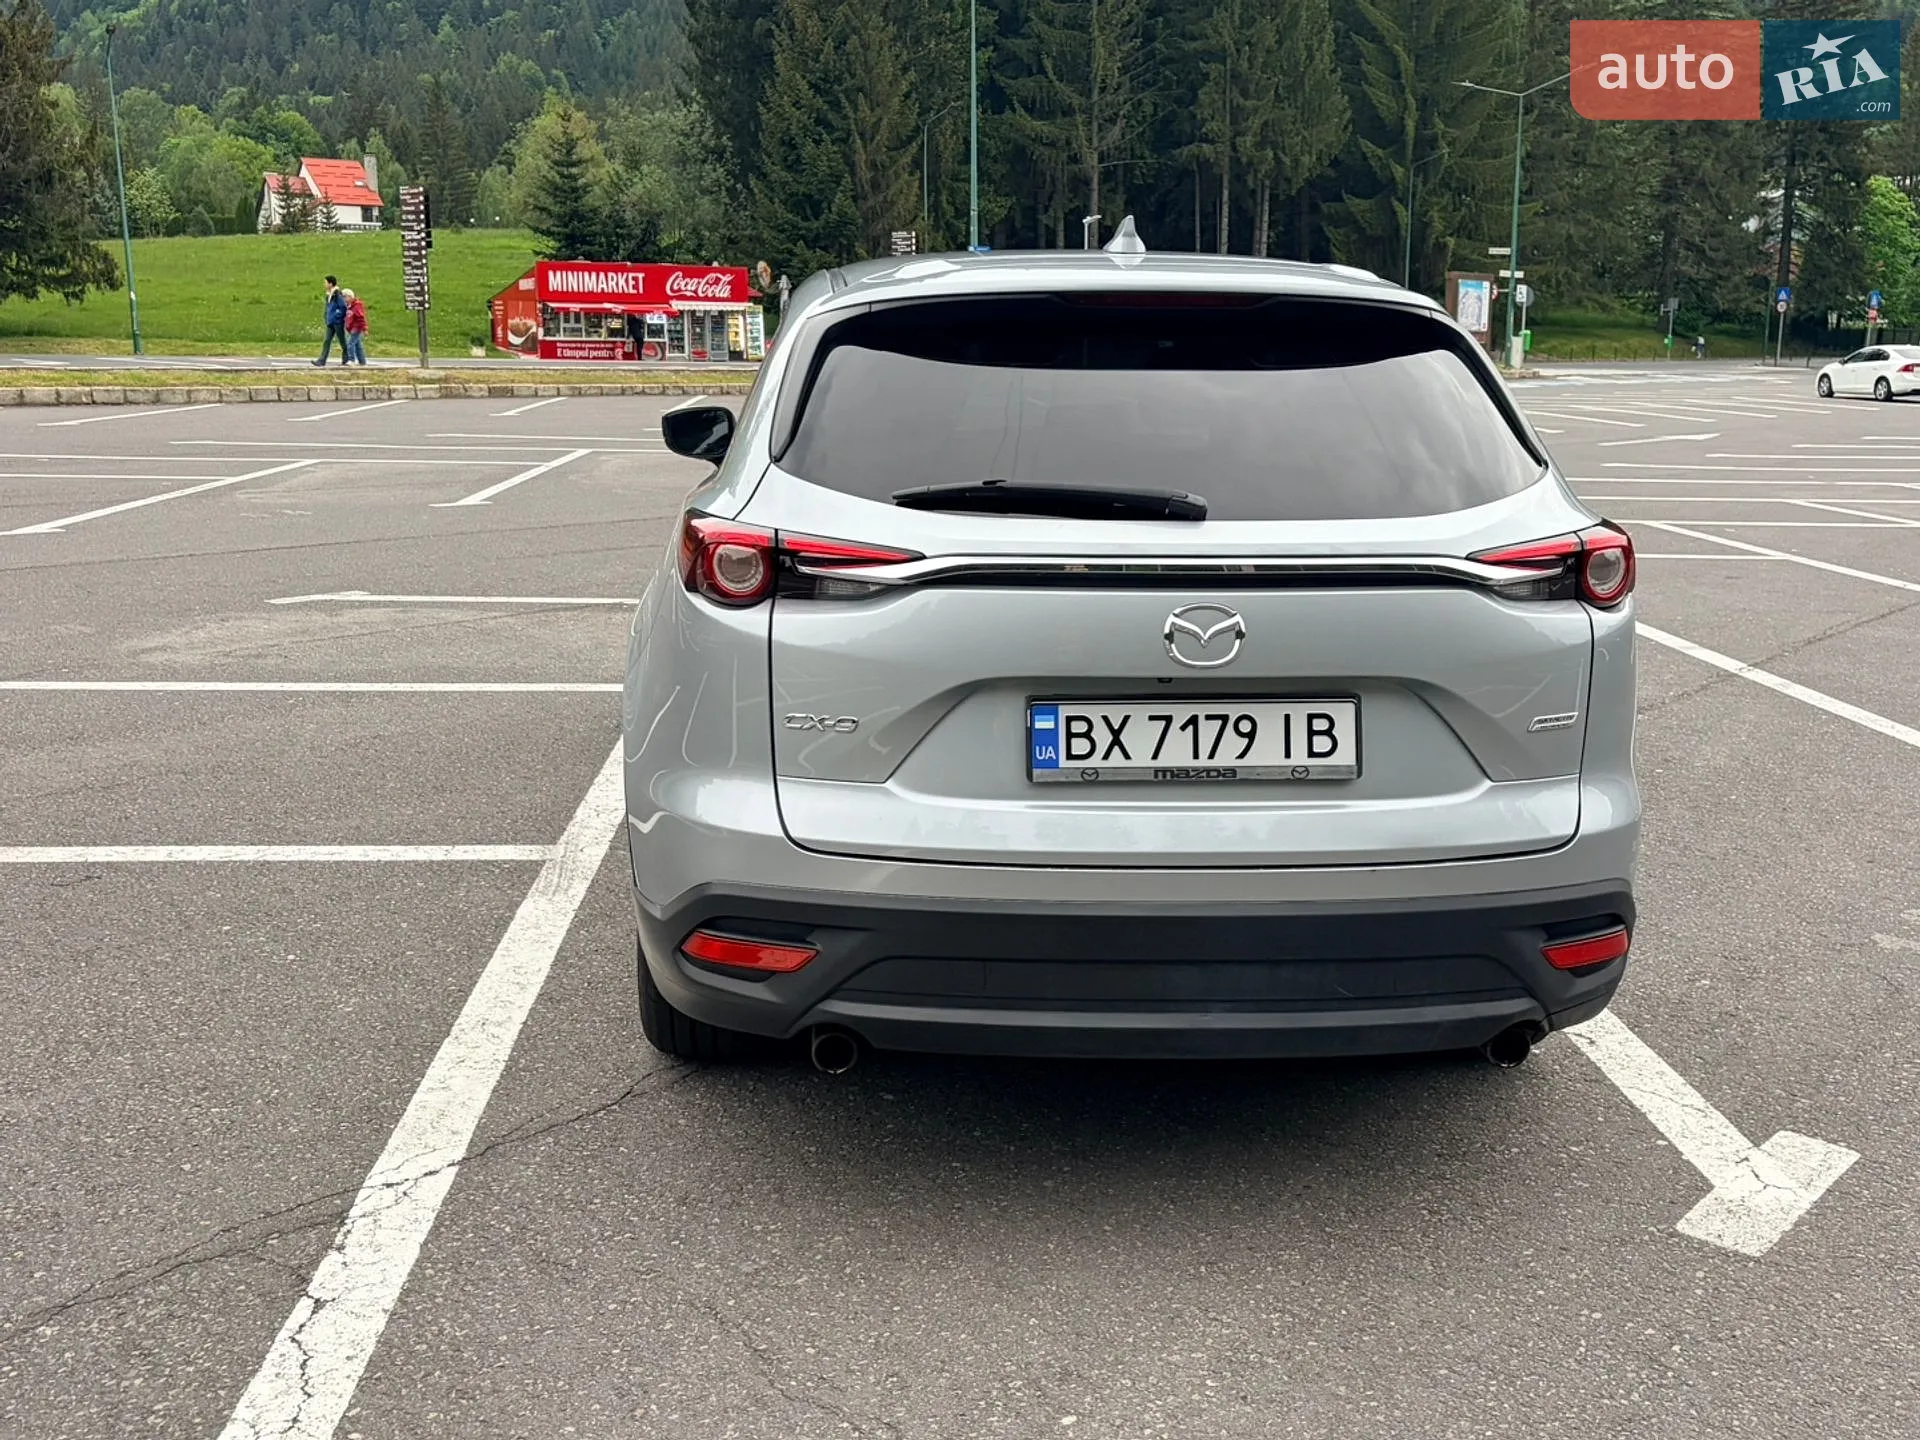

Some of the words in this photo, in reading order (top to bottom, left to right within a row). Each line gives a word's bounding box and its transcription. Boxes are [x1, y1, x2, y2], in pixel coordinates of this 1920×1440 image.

[547, 269, 646, 295] MINIMARKET
[665, 271, 735, 298] Coca-Cola
[1064, 714, 1132, 761] BX
[1148, 713, 1258, 760] 7179
[1283, 712, 1339, 760] IB
[1035, 745, 1057, 761] UA
